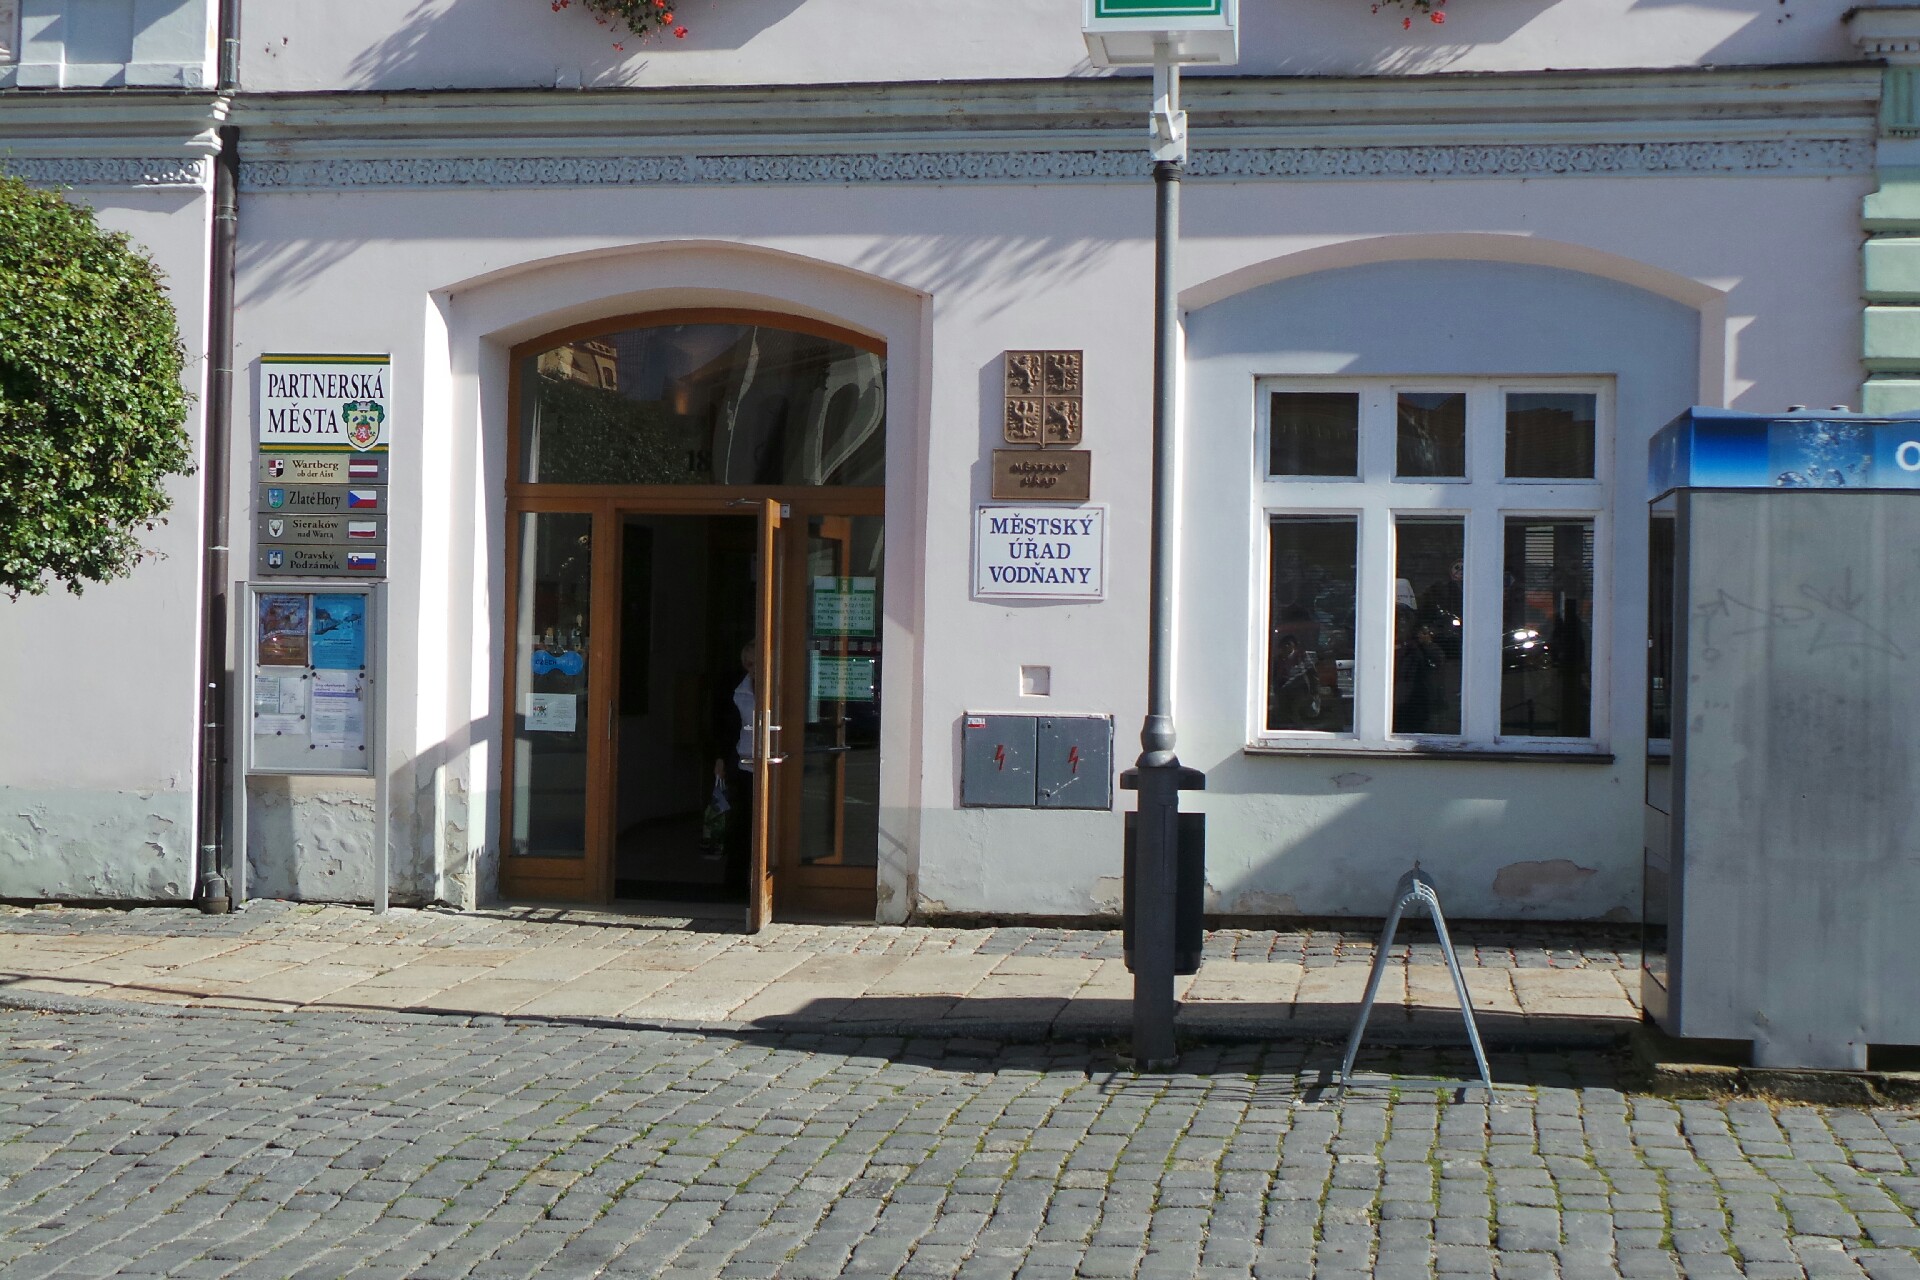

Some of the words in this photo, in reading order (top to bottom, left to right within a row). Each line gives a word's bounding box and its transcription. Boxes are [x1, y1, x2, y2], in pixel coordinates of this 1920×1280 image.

[267, 368, 385, 399] PARTNERSKÁ
[268, 402, 339, 433] MĚSTA
[292, 460, 339, 471] Wartberg
[296, 470, 306, 478] ob
[307, 470, 319, 478] der
[320, 470, 334, 478] Aist
[289, 491, 316, 505] Zlaté
[316, 491, 341, 510] Hory
[292, 519, 339, 529] Sieraków
[989, 513, 1093, 536] MĚSTSKÝ
[297, 530, 311, 538] nad
[294, 550, 335, 562] Oravský
[1008, 537, 1071, 560] ÚŘAD
[290, 560, 341, 570] Podzámok
[988, 562, 1092, 584] VODŇANY
